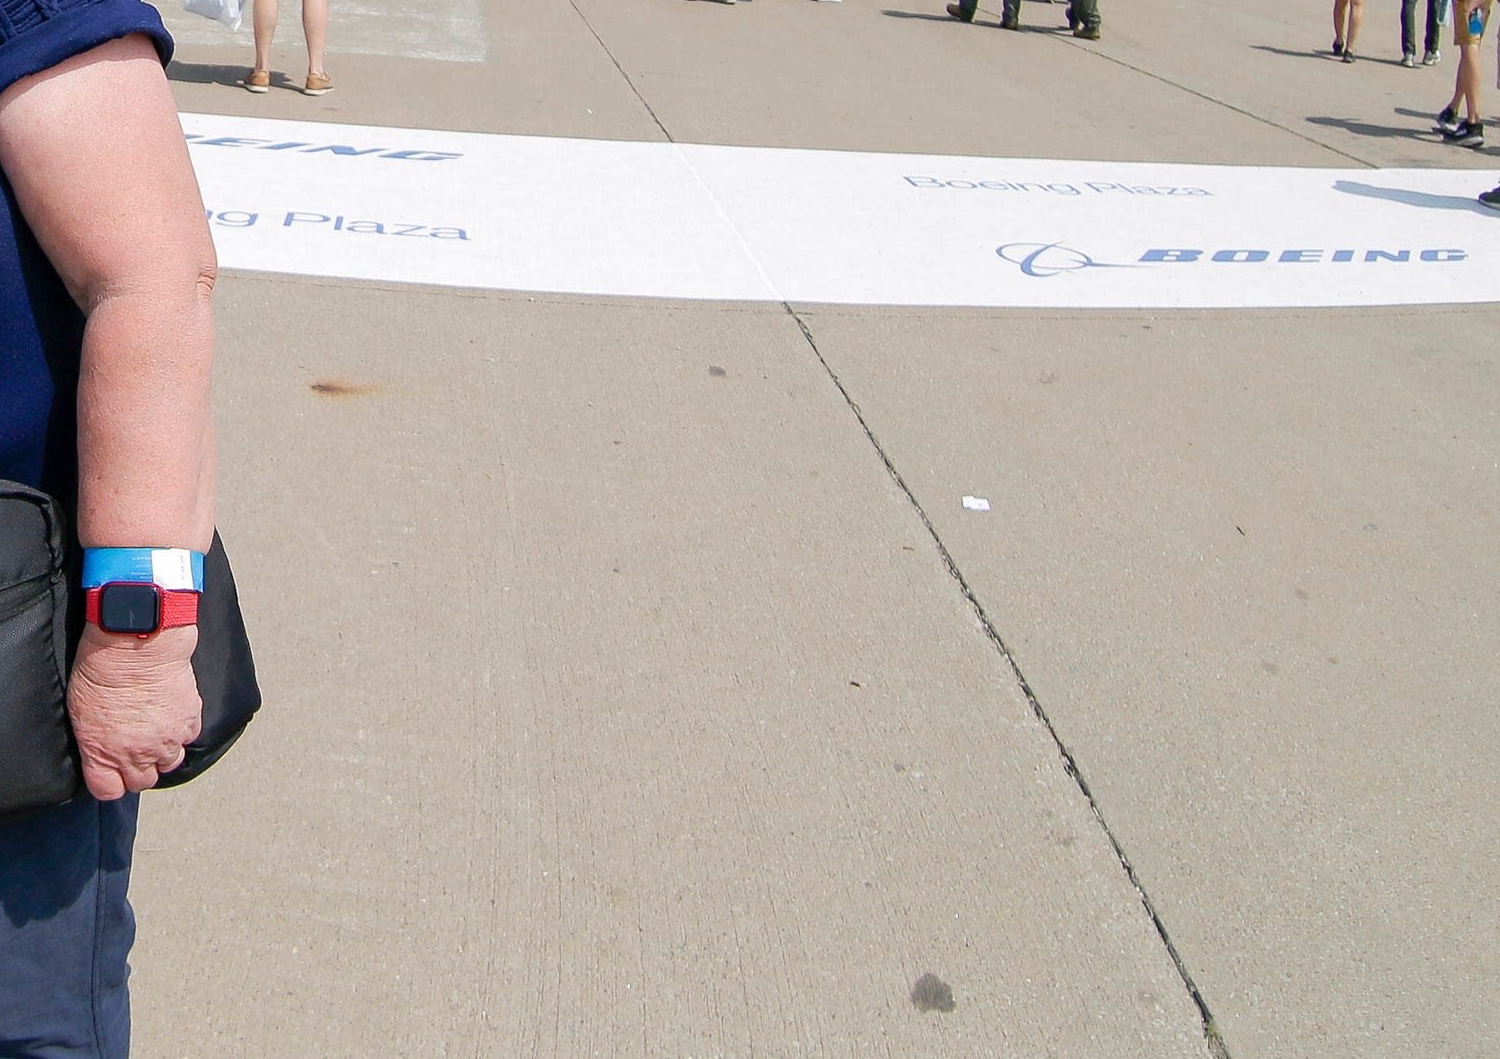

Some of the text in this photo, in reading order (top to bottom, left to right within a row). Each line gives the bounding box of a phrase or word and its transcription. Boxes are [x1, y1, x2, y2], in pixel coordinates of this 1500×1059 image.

[185, 133, 464, 161] EING
[903, 175, 1216, 196] Boeing Plaza
[283, 211, 471, 240] Plaza
[1138, 249, 1469, 263] BOEING
